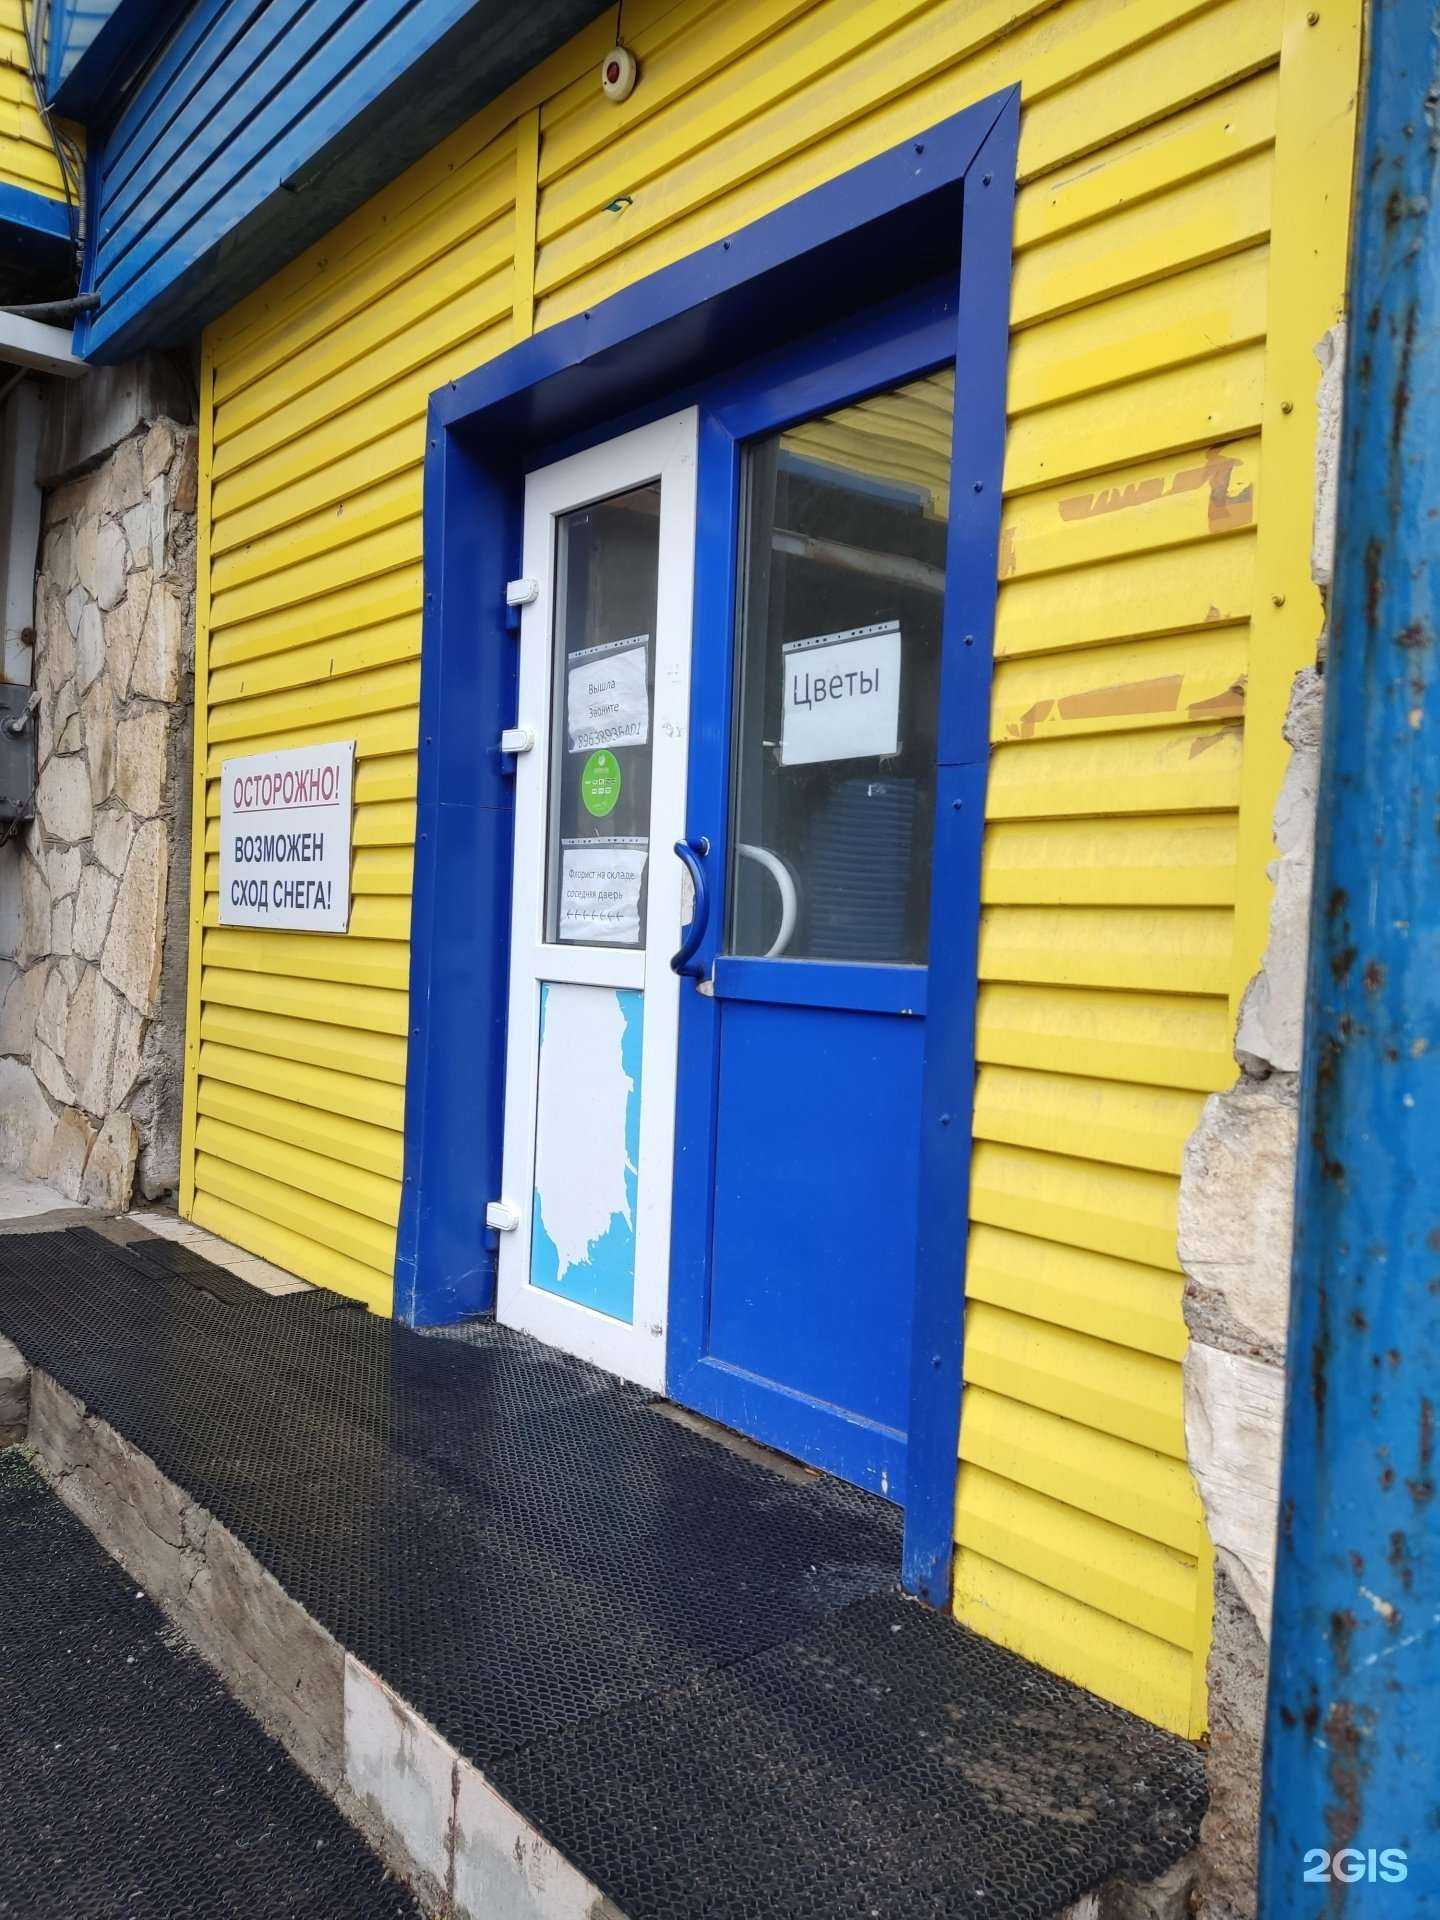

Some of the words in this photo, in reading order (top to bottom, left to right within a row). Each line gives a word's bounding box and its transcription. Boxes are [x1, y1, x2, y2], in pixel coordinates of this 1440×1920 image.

[588, 680, 616, 695] Вышла
[793, 668, 879, 711] Цветы
[233, 765, 340, 809] ОСТОРОЖНО!
[234, 832, 324, 863] ВОЗМОЖЕН
[231, 879, 269, 913] СХОД
[273, 880, 332, 910] СНЕГА!
[598, 891, 623, 902] дверь
